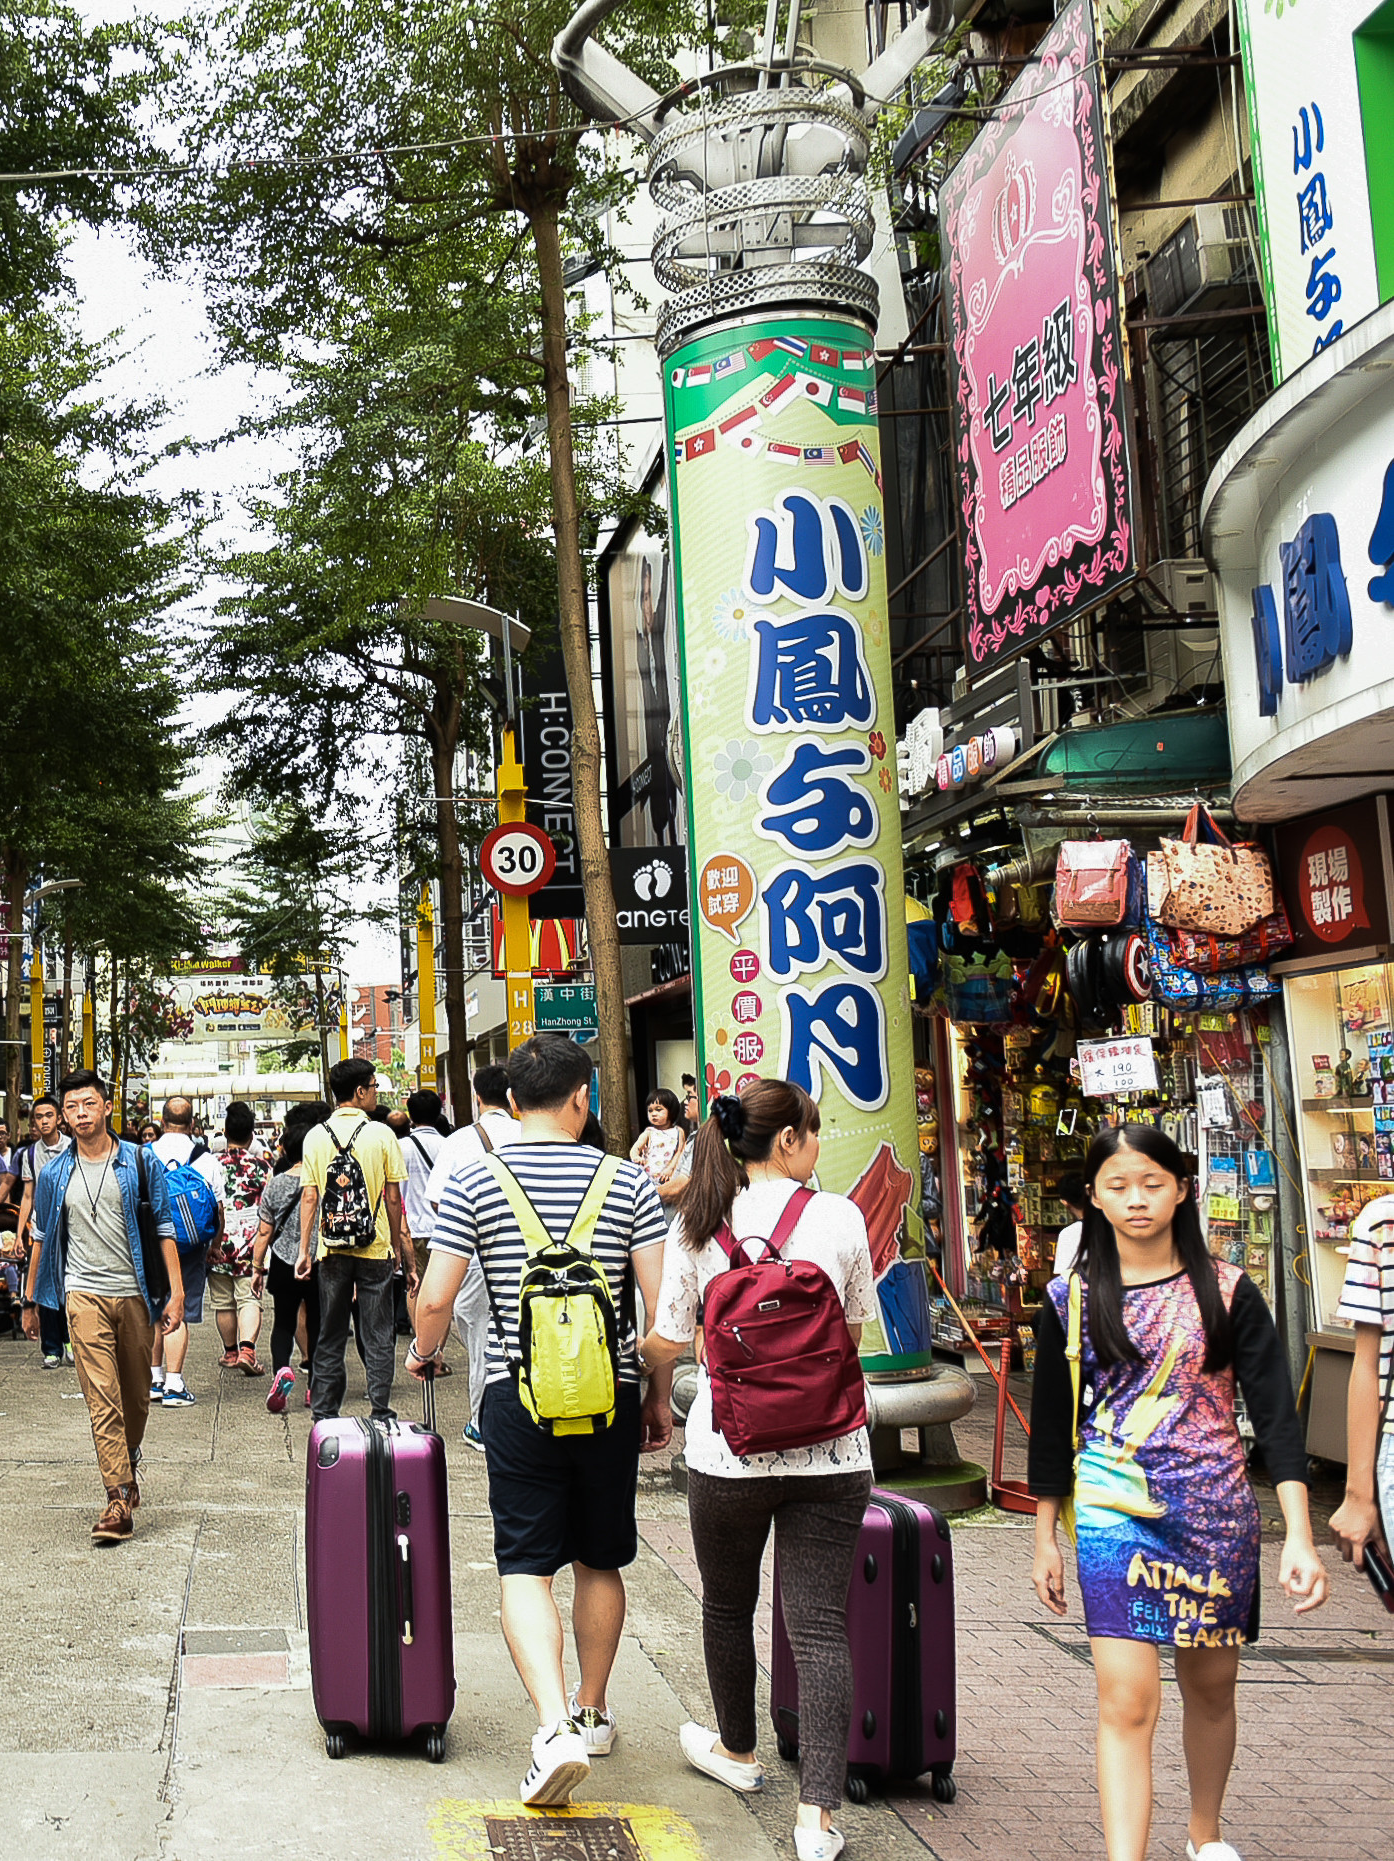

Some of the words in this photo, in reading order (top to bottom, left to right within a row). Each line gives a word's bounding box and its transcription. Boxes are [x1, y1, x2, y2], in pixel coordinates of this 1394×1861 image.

[983, 297, 1077, 454] 七年級
[999, 411, 1068, 512] 精品服飾
[498, 846, 537, 874] 30
[1307, 845, 1350, 889] 現場
[707, 867, 739, 889] 歡迎
[708, 892, 740, 916] 試穿
[1311, 885, 1353, 926] 製作
[513, 989, 528, 1009] H
[539, 988, 595, 1003] 漢中街
[511, 1020, 533, 1036] 28
[541, 1016, 582, 1028] HanZhong
[583, 1015, 595, 1026] St.
[424, 1046, 434, 1057] H
[43, 1059, 52, 1093] TOUGH
[421, 1064, 436, 1075] 30
[1112, 1062, 1133, 1074] 190
[1115, 1078, 1134, 1087] 100
[1164, 1593, 1218, 1624] THE
